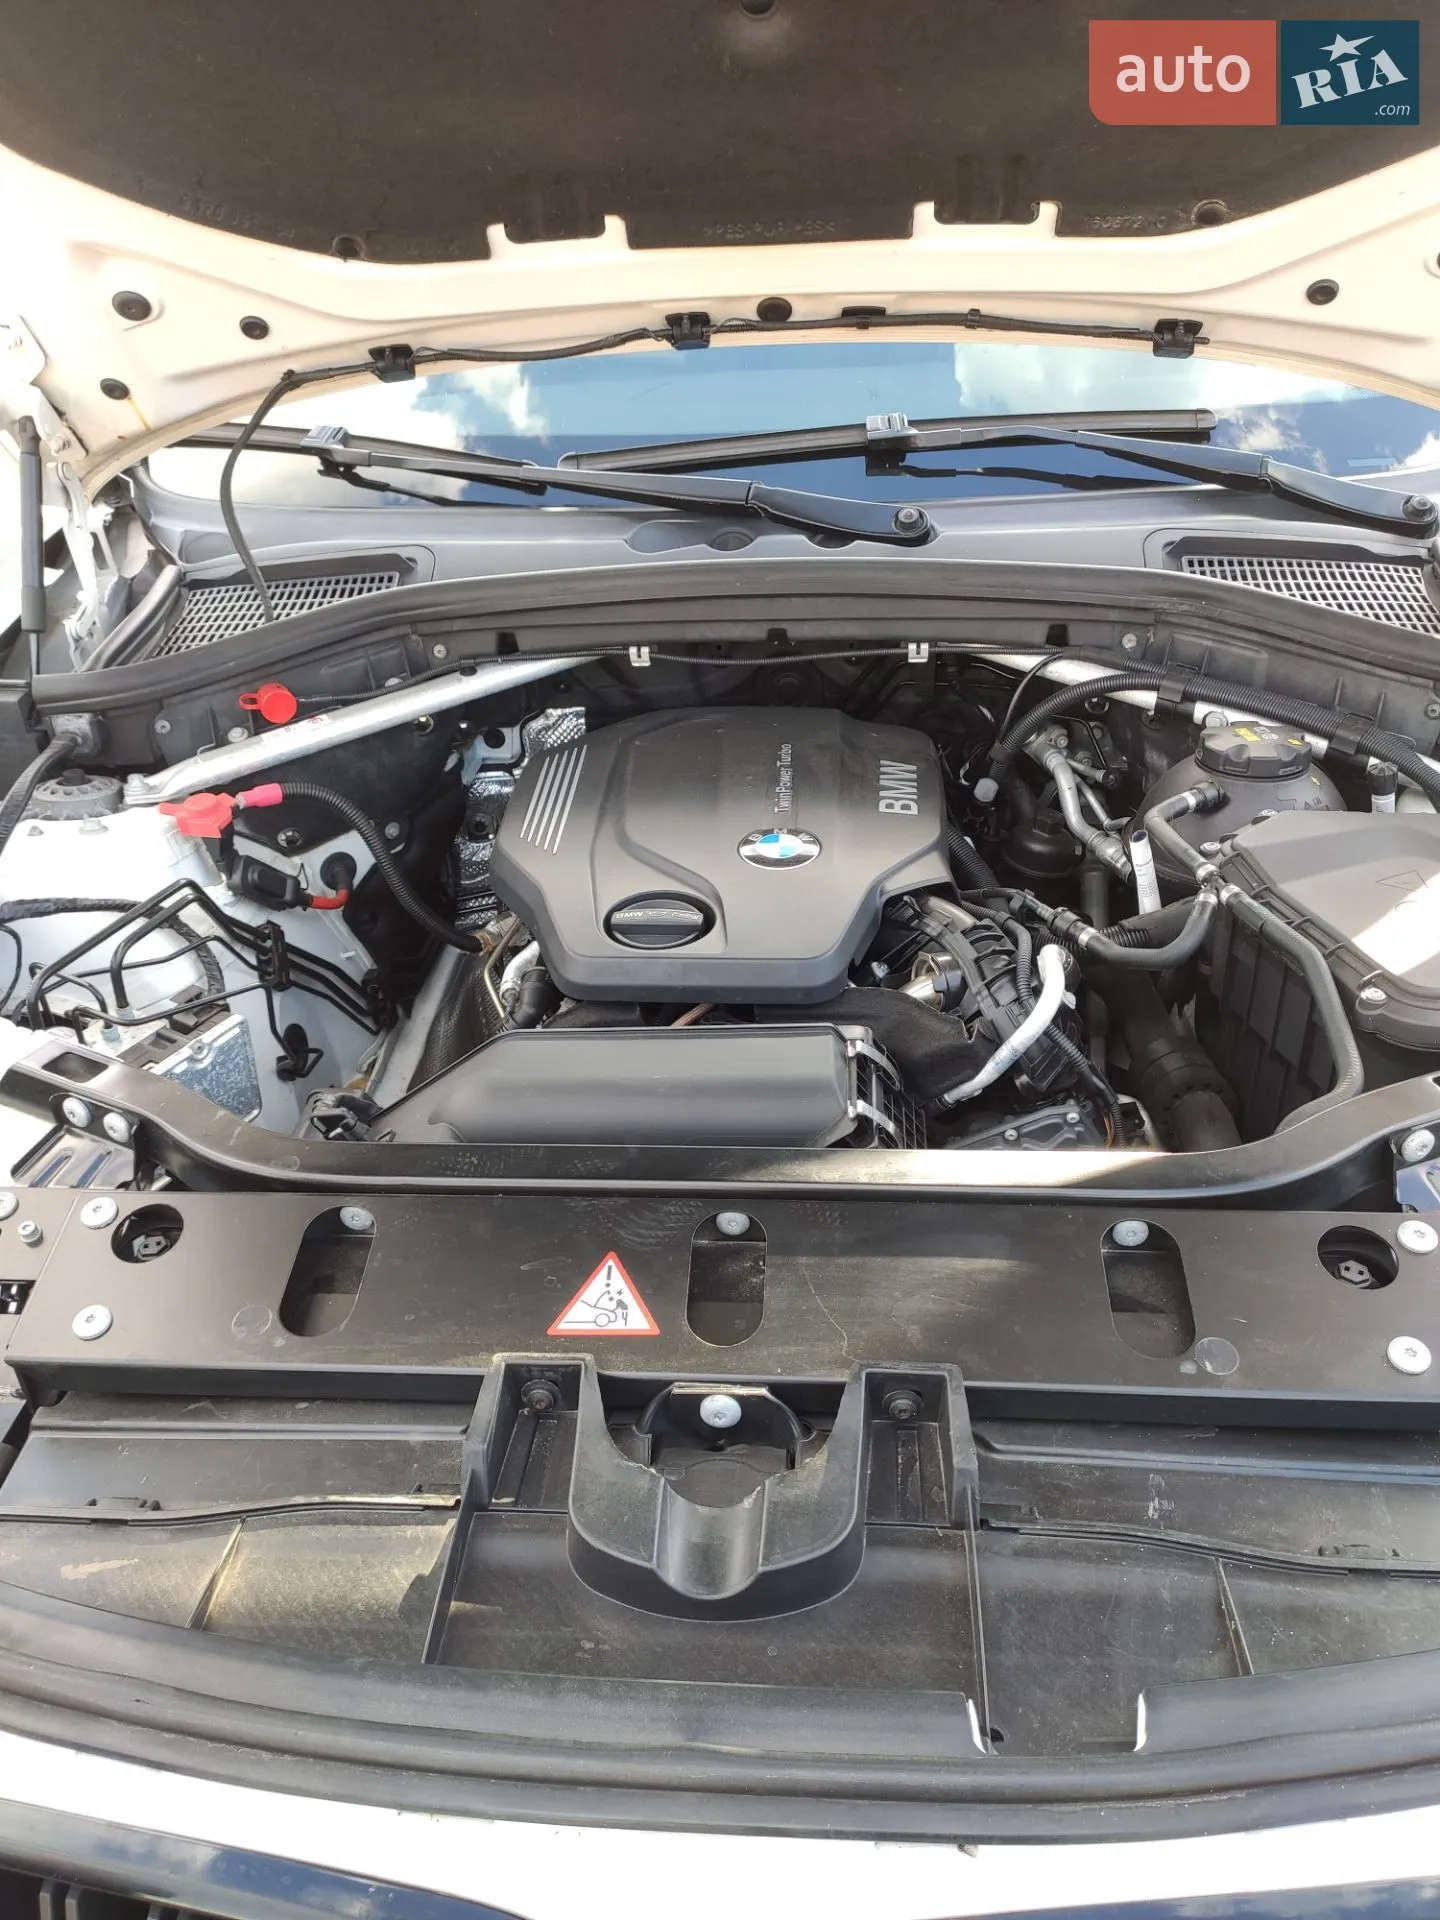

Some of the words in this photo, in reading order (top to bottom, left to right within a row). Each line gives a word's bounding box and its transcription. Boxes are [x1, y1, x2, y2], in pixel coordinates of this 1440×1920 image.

[776, 743, 792, 766] Turbo
[774, 766, 792, 813] TwinPower
[878, 759, 918, 815] BMW
[747, 828, 813, 841] BMW
[616, 911, 643, 919] BMW
